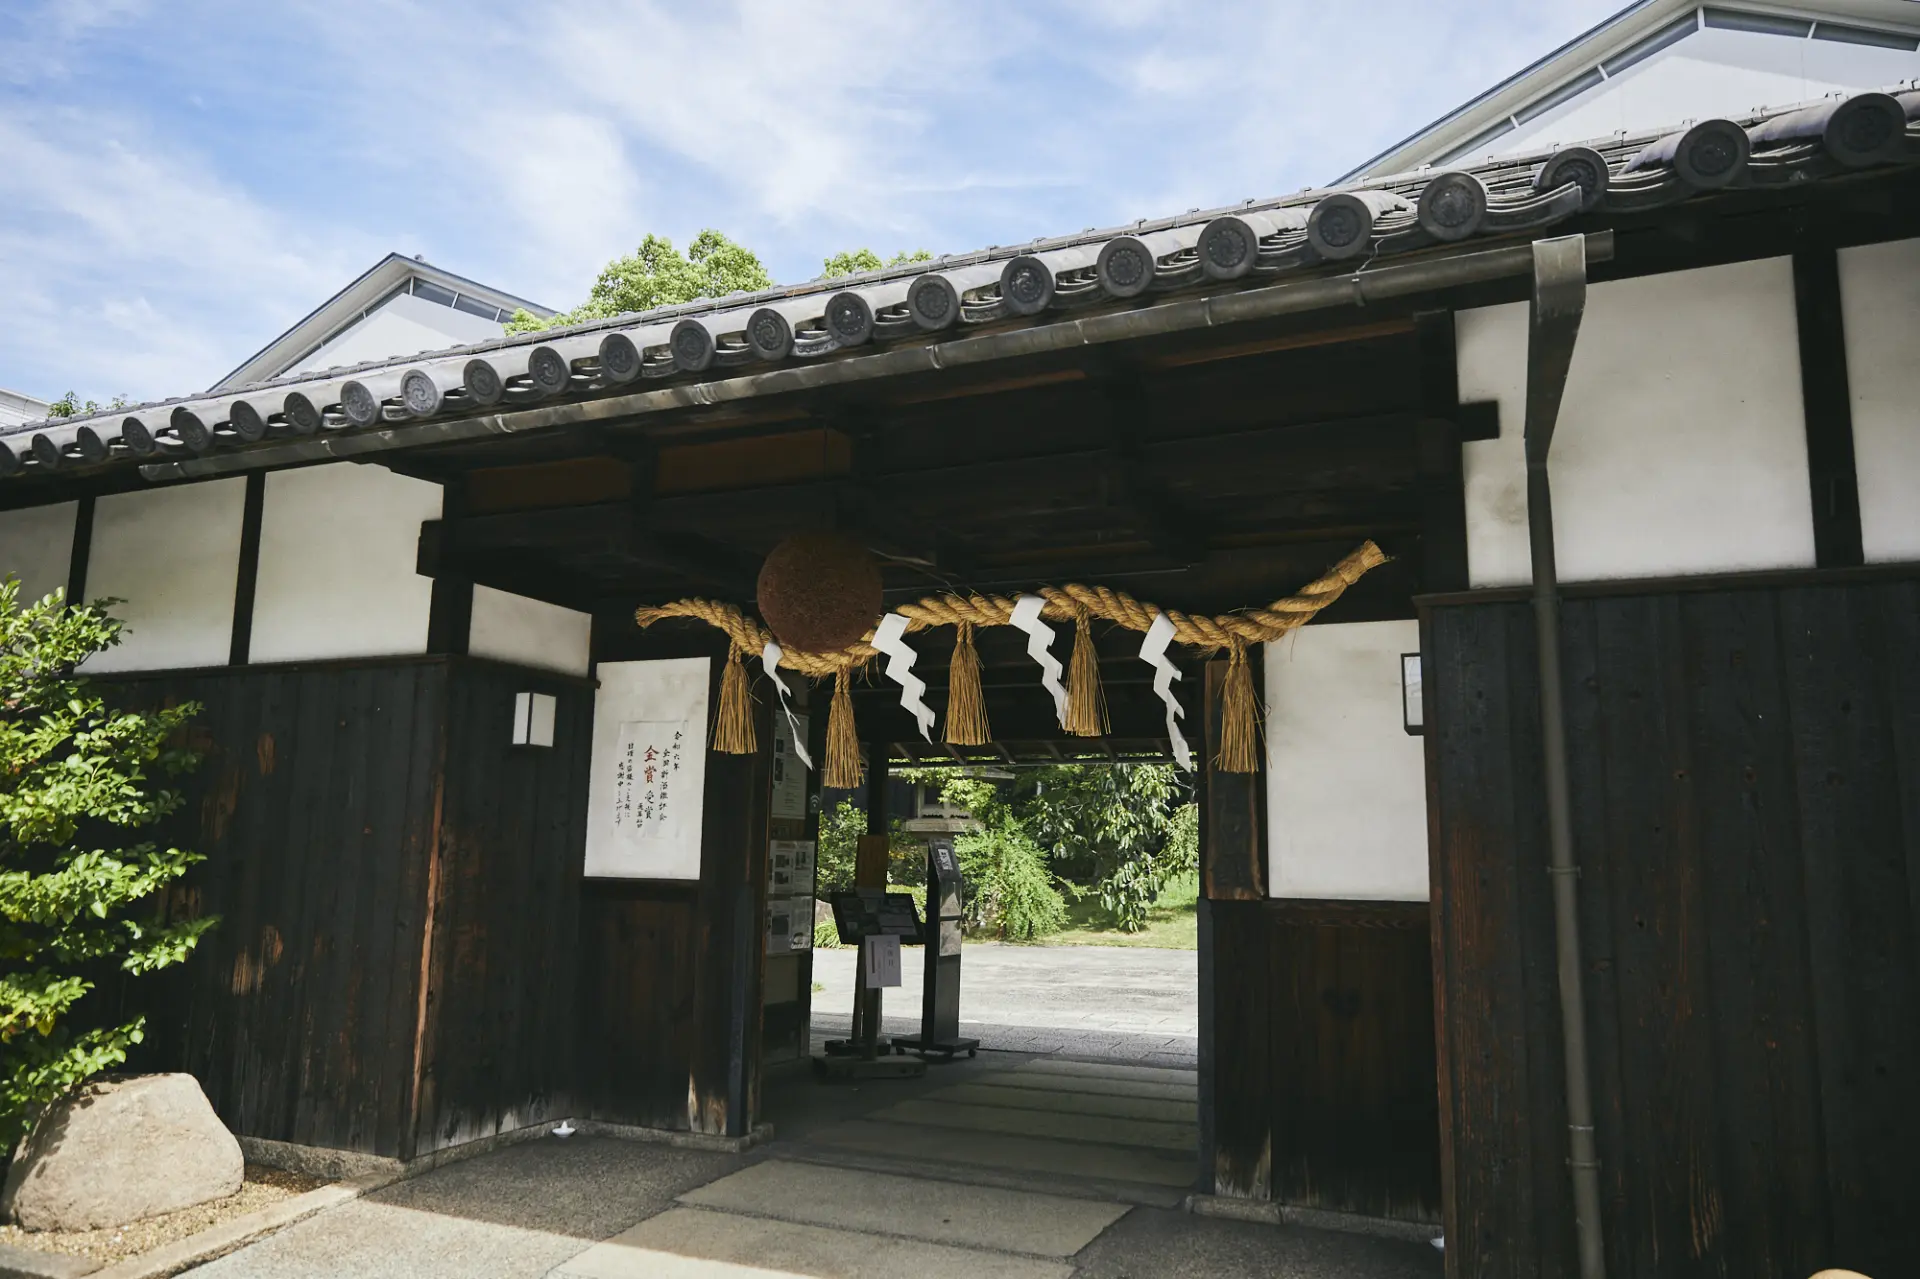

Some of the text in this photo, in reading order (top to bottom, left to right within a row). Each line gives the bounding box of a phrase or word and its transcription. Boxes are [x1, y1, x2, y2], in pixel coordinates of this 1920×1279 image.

[672, 731, 683, 771] 令和六年
[644, 745, 660, 819] 金賞受賞
